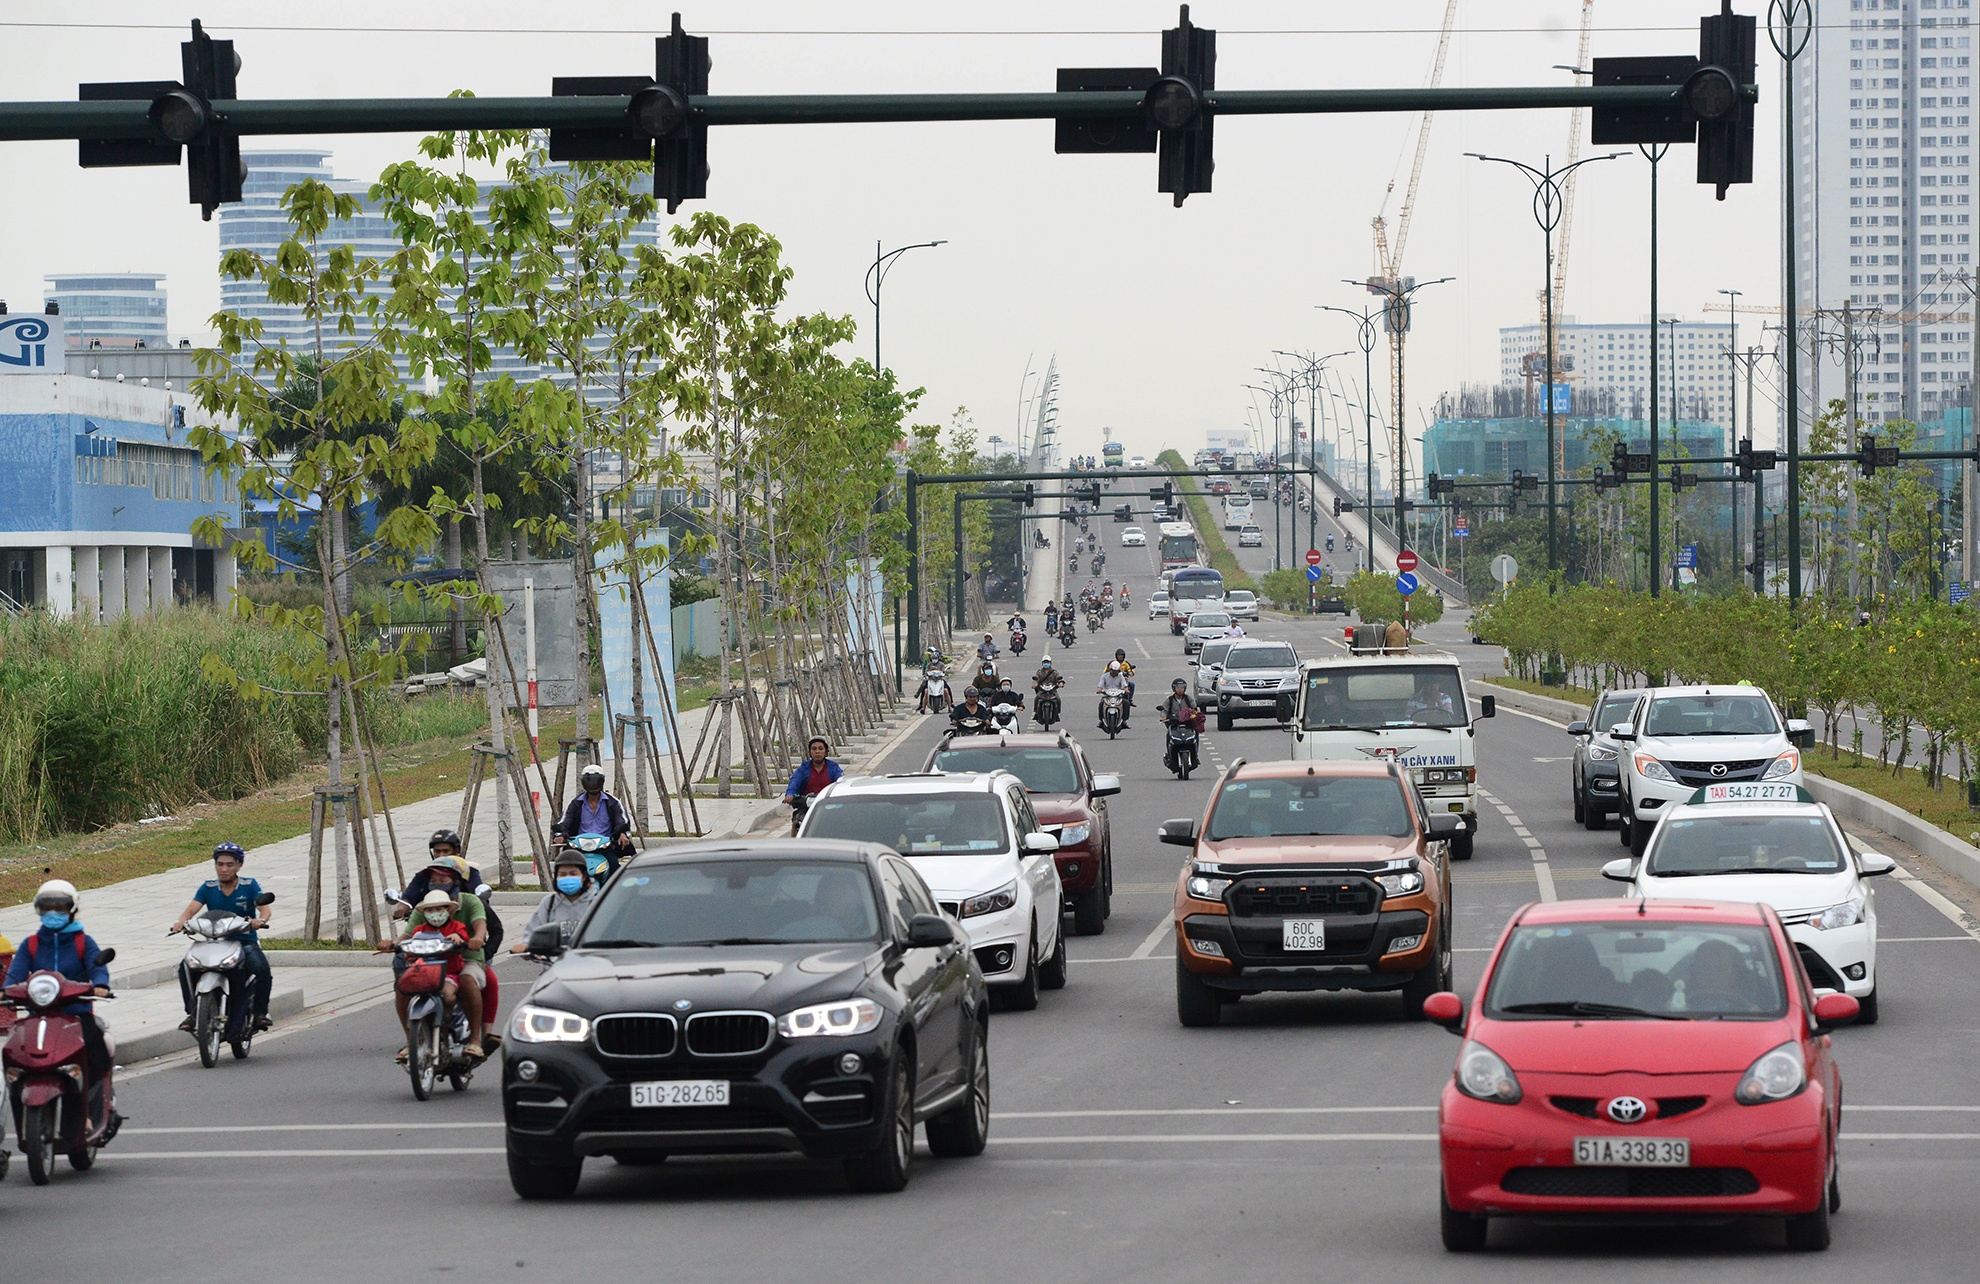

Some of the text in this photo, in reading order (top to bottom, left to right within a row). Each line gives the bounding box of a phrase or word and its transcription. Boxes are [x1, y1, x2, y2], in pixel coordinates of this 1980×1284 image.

[1410, 754, 1428, 767] CÂY
[1430, 755, 1456, 766] XANH
[1710, 786, 1792, 799] TAXI 54.27 27 27
[1239, 891, 1369, 906] FORD
[1293, 922, 1315, 935] 60C
[1284, 935, 1324, 949] 402.98
[634, 1084, 726, 1105] 51G-282.65
